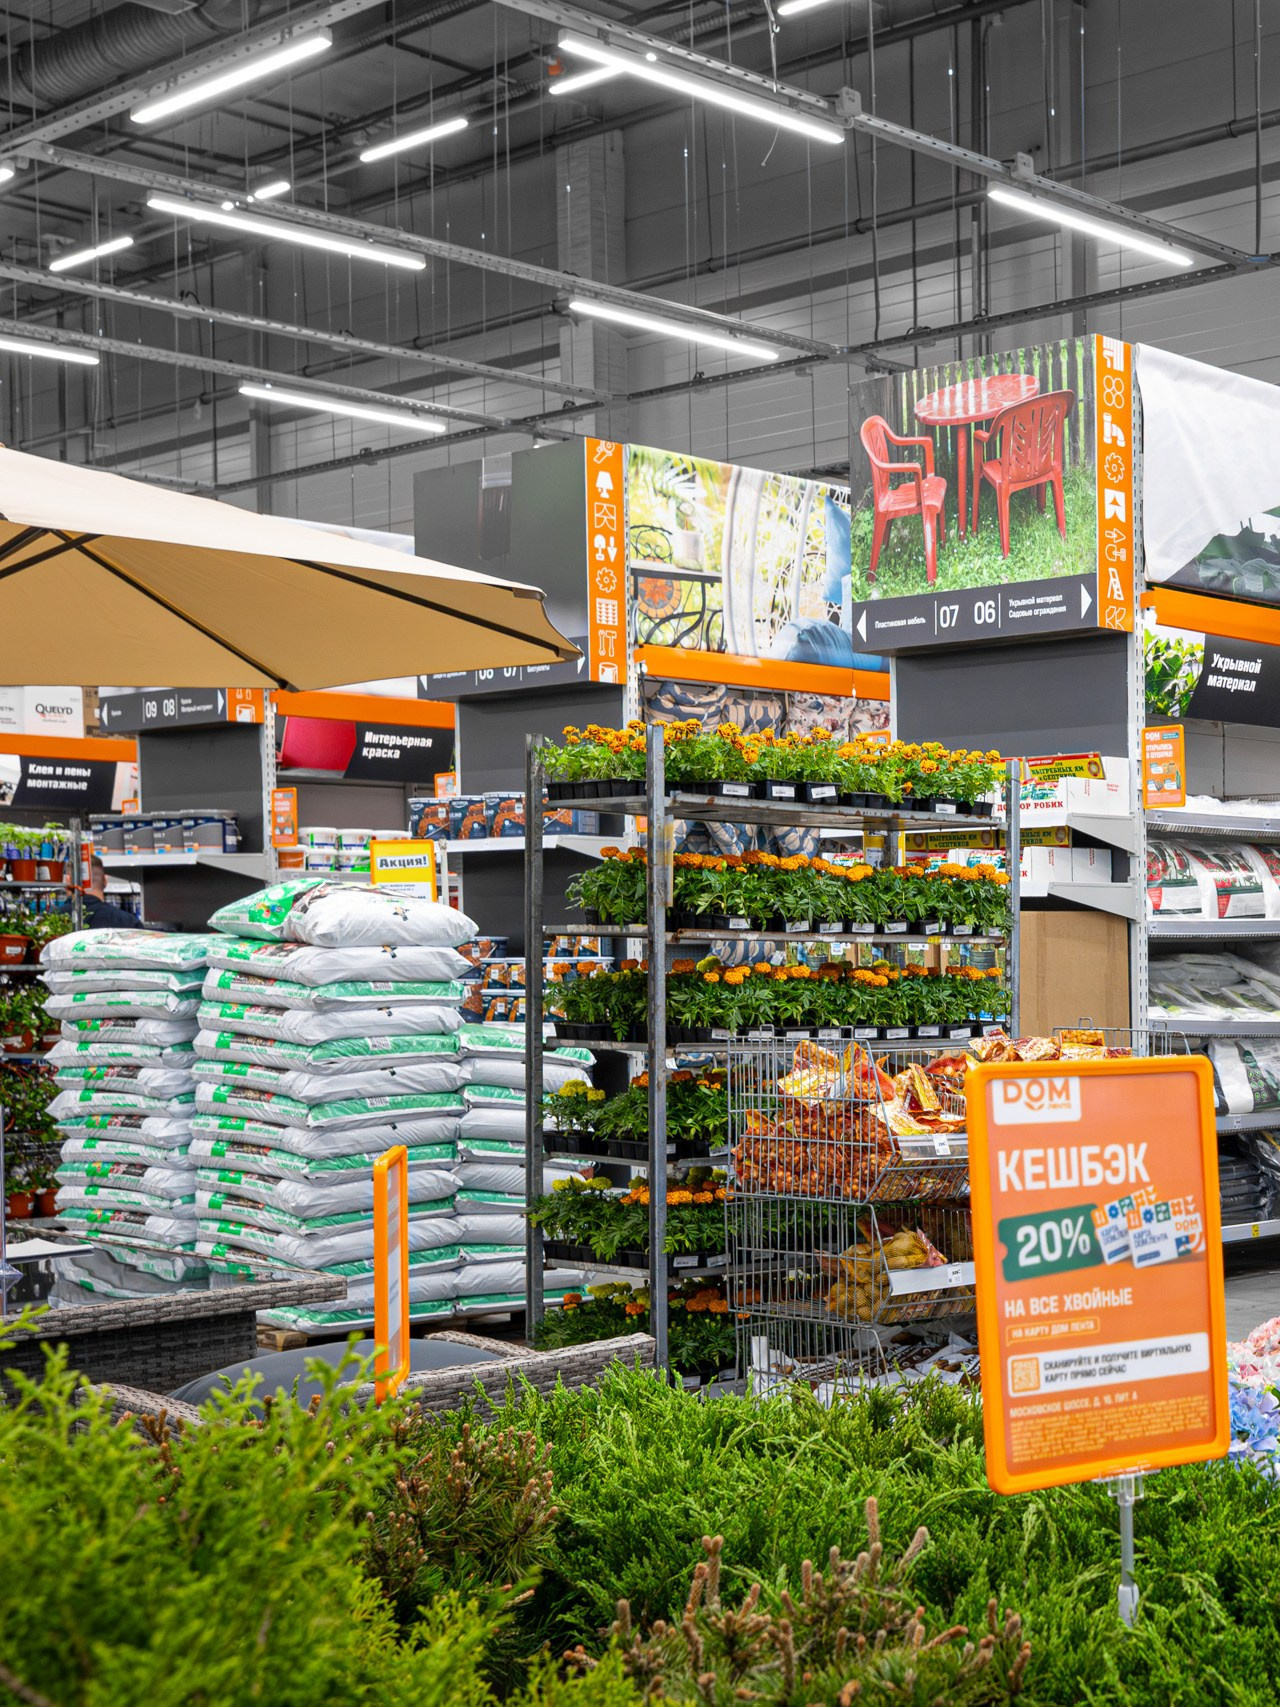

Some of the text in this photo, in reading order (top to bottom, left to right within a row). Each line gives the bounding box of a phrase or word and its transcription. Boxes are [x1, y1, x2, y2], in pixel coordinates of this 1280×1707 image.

[939, 605, 960, 628] 07
[973, 600, 996, 624] 06
[1211, 653, 1262, 675] Укрывной
[1206, 673, 1256, 693] материал
[35, 703, 73, 717] QUELYD
[145, 701, 157, 718] 09
[162, 699, 176, 717] 08
[364, 731, 433, 748] Интерьерная
[362, 746, 400, 760] краска
[29, 763, 91, 777] Клея и пены
[27, 778, 88, 791] монтажные
[997, 801, 1064, 812] ДООР РОБИК
[379, 856, 428, 868] Акция!
[1002, 1078, 1071, 1104] DOM
[998, 1142, 1150, 1193] КЕШБЭК
[1016, 1215, 1091, 1268] 20%
[1004, 1287, 1133, 1318] НА ВСЕ ХВОЙНЫЕ
[1012, 1320, 1094, 1338] НА КАРТУ ДОМ ЛЕНТА
[1043, 1343, 1192, 1371] СКАНИРУЙТЕ И ПОЛУЧИТЕ ВИРТУАЛЬНУЮ
[1044, 1363, 1127, 1383] КАРТУ ПРЯМО СЕЙЧАС
[1132, 1391, 1138, 1401] А
